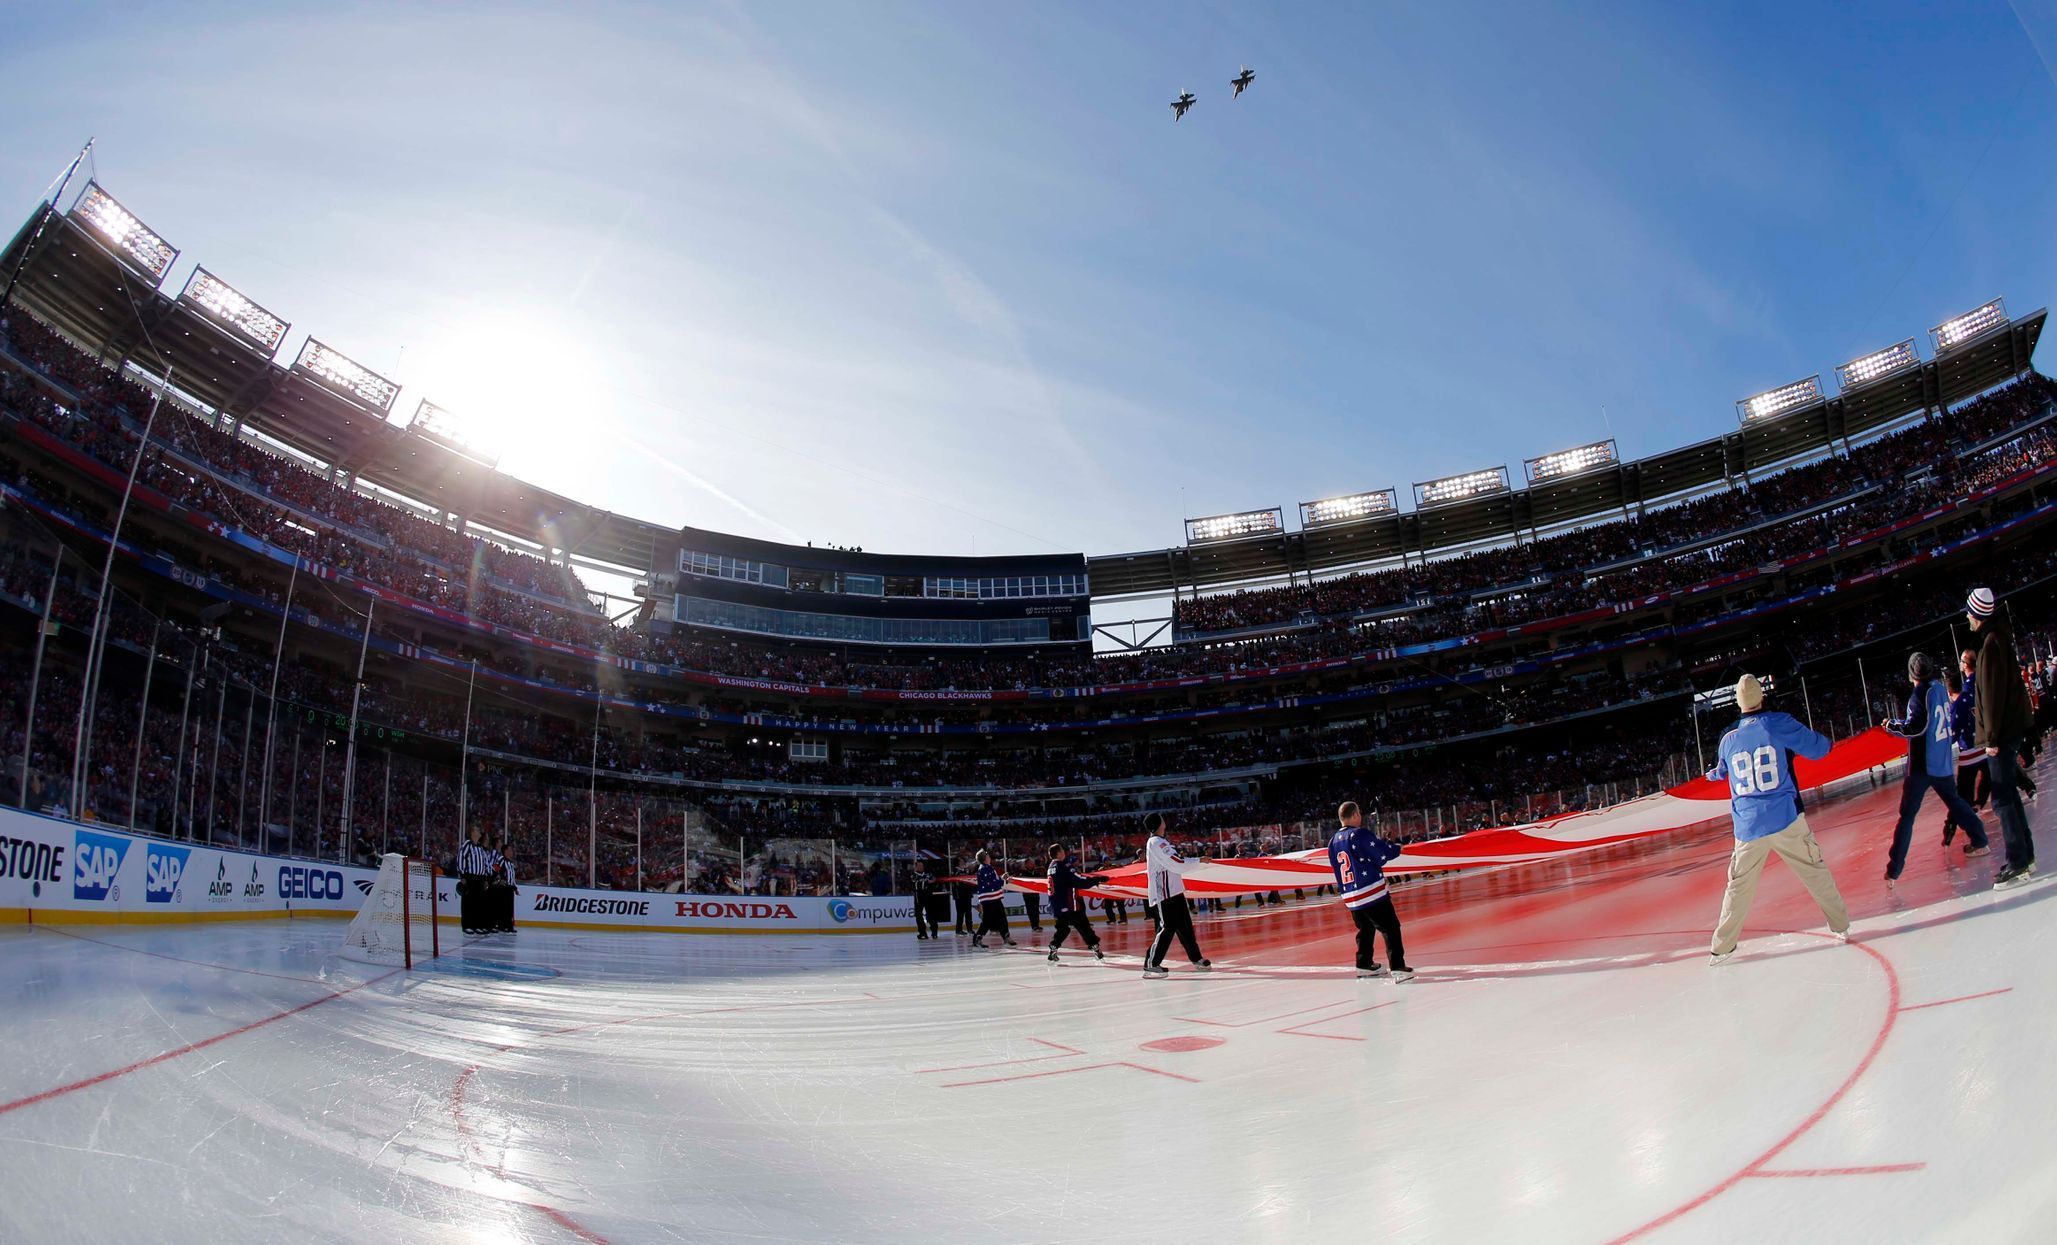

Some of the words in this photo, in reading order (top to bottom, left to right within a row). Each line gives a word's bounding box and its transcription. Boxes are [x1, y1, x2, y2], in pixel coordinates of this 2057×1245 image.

[717, 677, 771, 689] WASHINGTON
[772, 683, 810, 694] CAPITALS
[775, 719, 818, 729] HAPPY
[828, 722, 857, 731] NEW
[874, 725, 910, 733] YEAR
[1731, 745, 1780, 796] 98
[75, 843, 119, 888] SAP
[147, 854, 181, 892] SAP
[1336, 850, 1355, 885] 2
[208, 881, 233, 896] AMP
[244, 884, 265, 897] AMP
[278, 866, 343, 900] GEICO
[533, 893, 650, 915] BRIDGESTONE
[674, 901, 798, 919] HONDA
